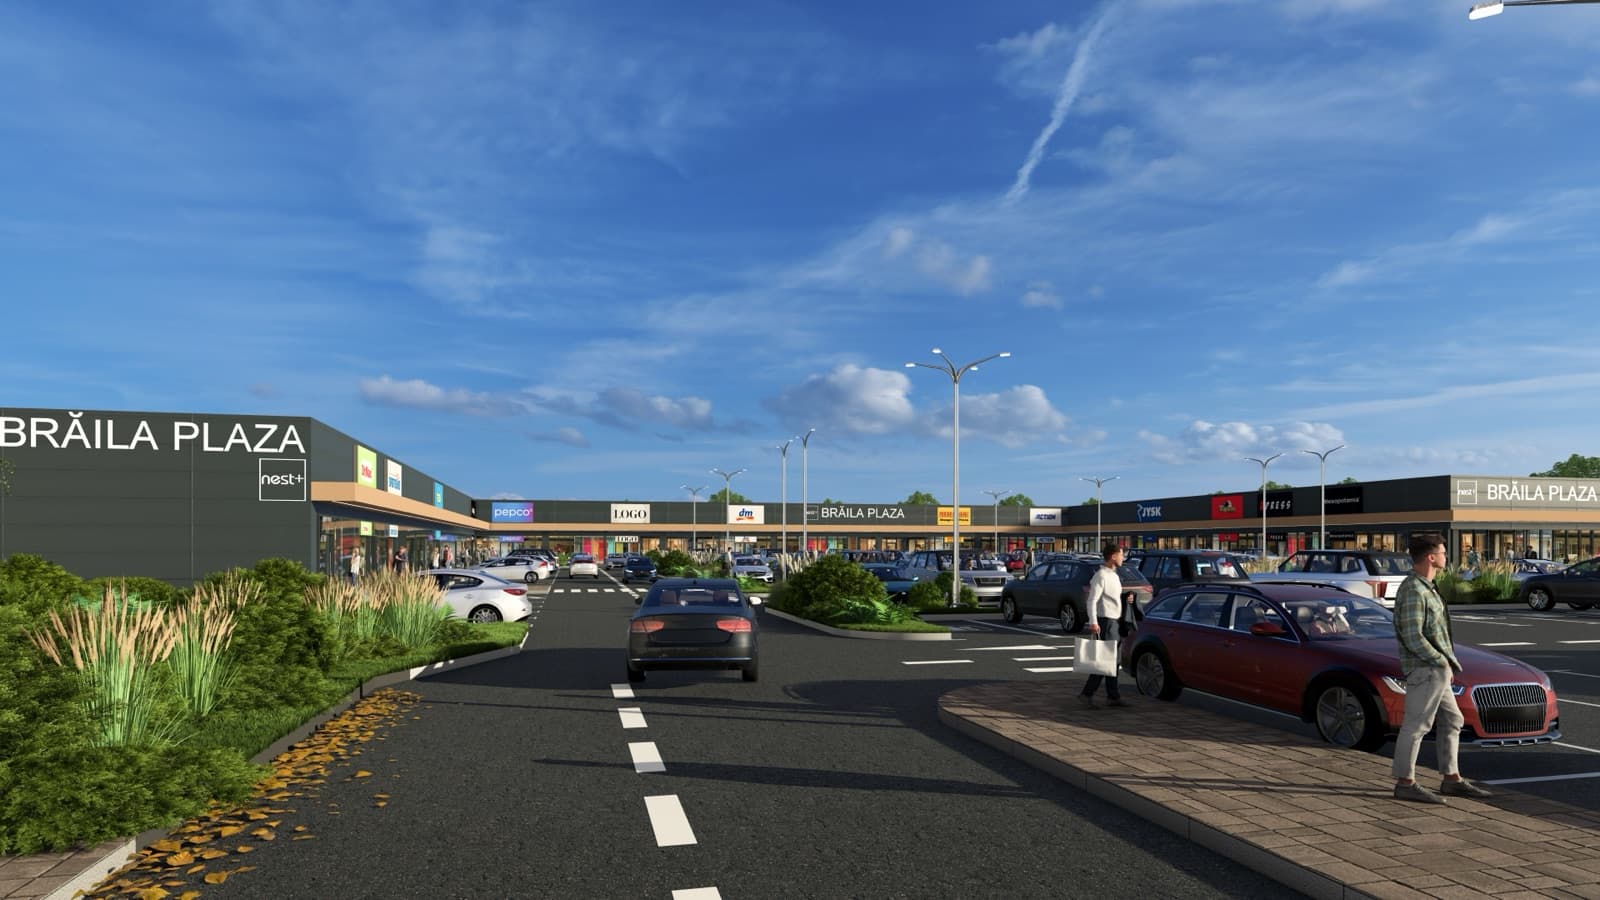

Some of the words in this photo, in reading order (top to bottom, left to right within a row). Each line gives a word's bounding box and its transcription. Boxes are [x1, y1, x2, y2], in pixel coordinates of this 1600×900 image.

[0, 411, 159, 450] BRĂILA
[173, 421, 306, 453] PLAZA
[1487, 480, 1544, 500] BRĂILA
[1548, 485, 1597, 502] PLAZA
[494, 508, 530, 518] pepco
[614, 508, 647, 519] LOGO
[738, 507, 753, 517] dm
[821, 503, 864, 518] BRĂILA
[867, 507, 905, 519] PLAZA
[1142, 503, 1161, 518] JYSK
